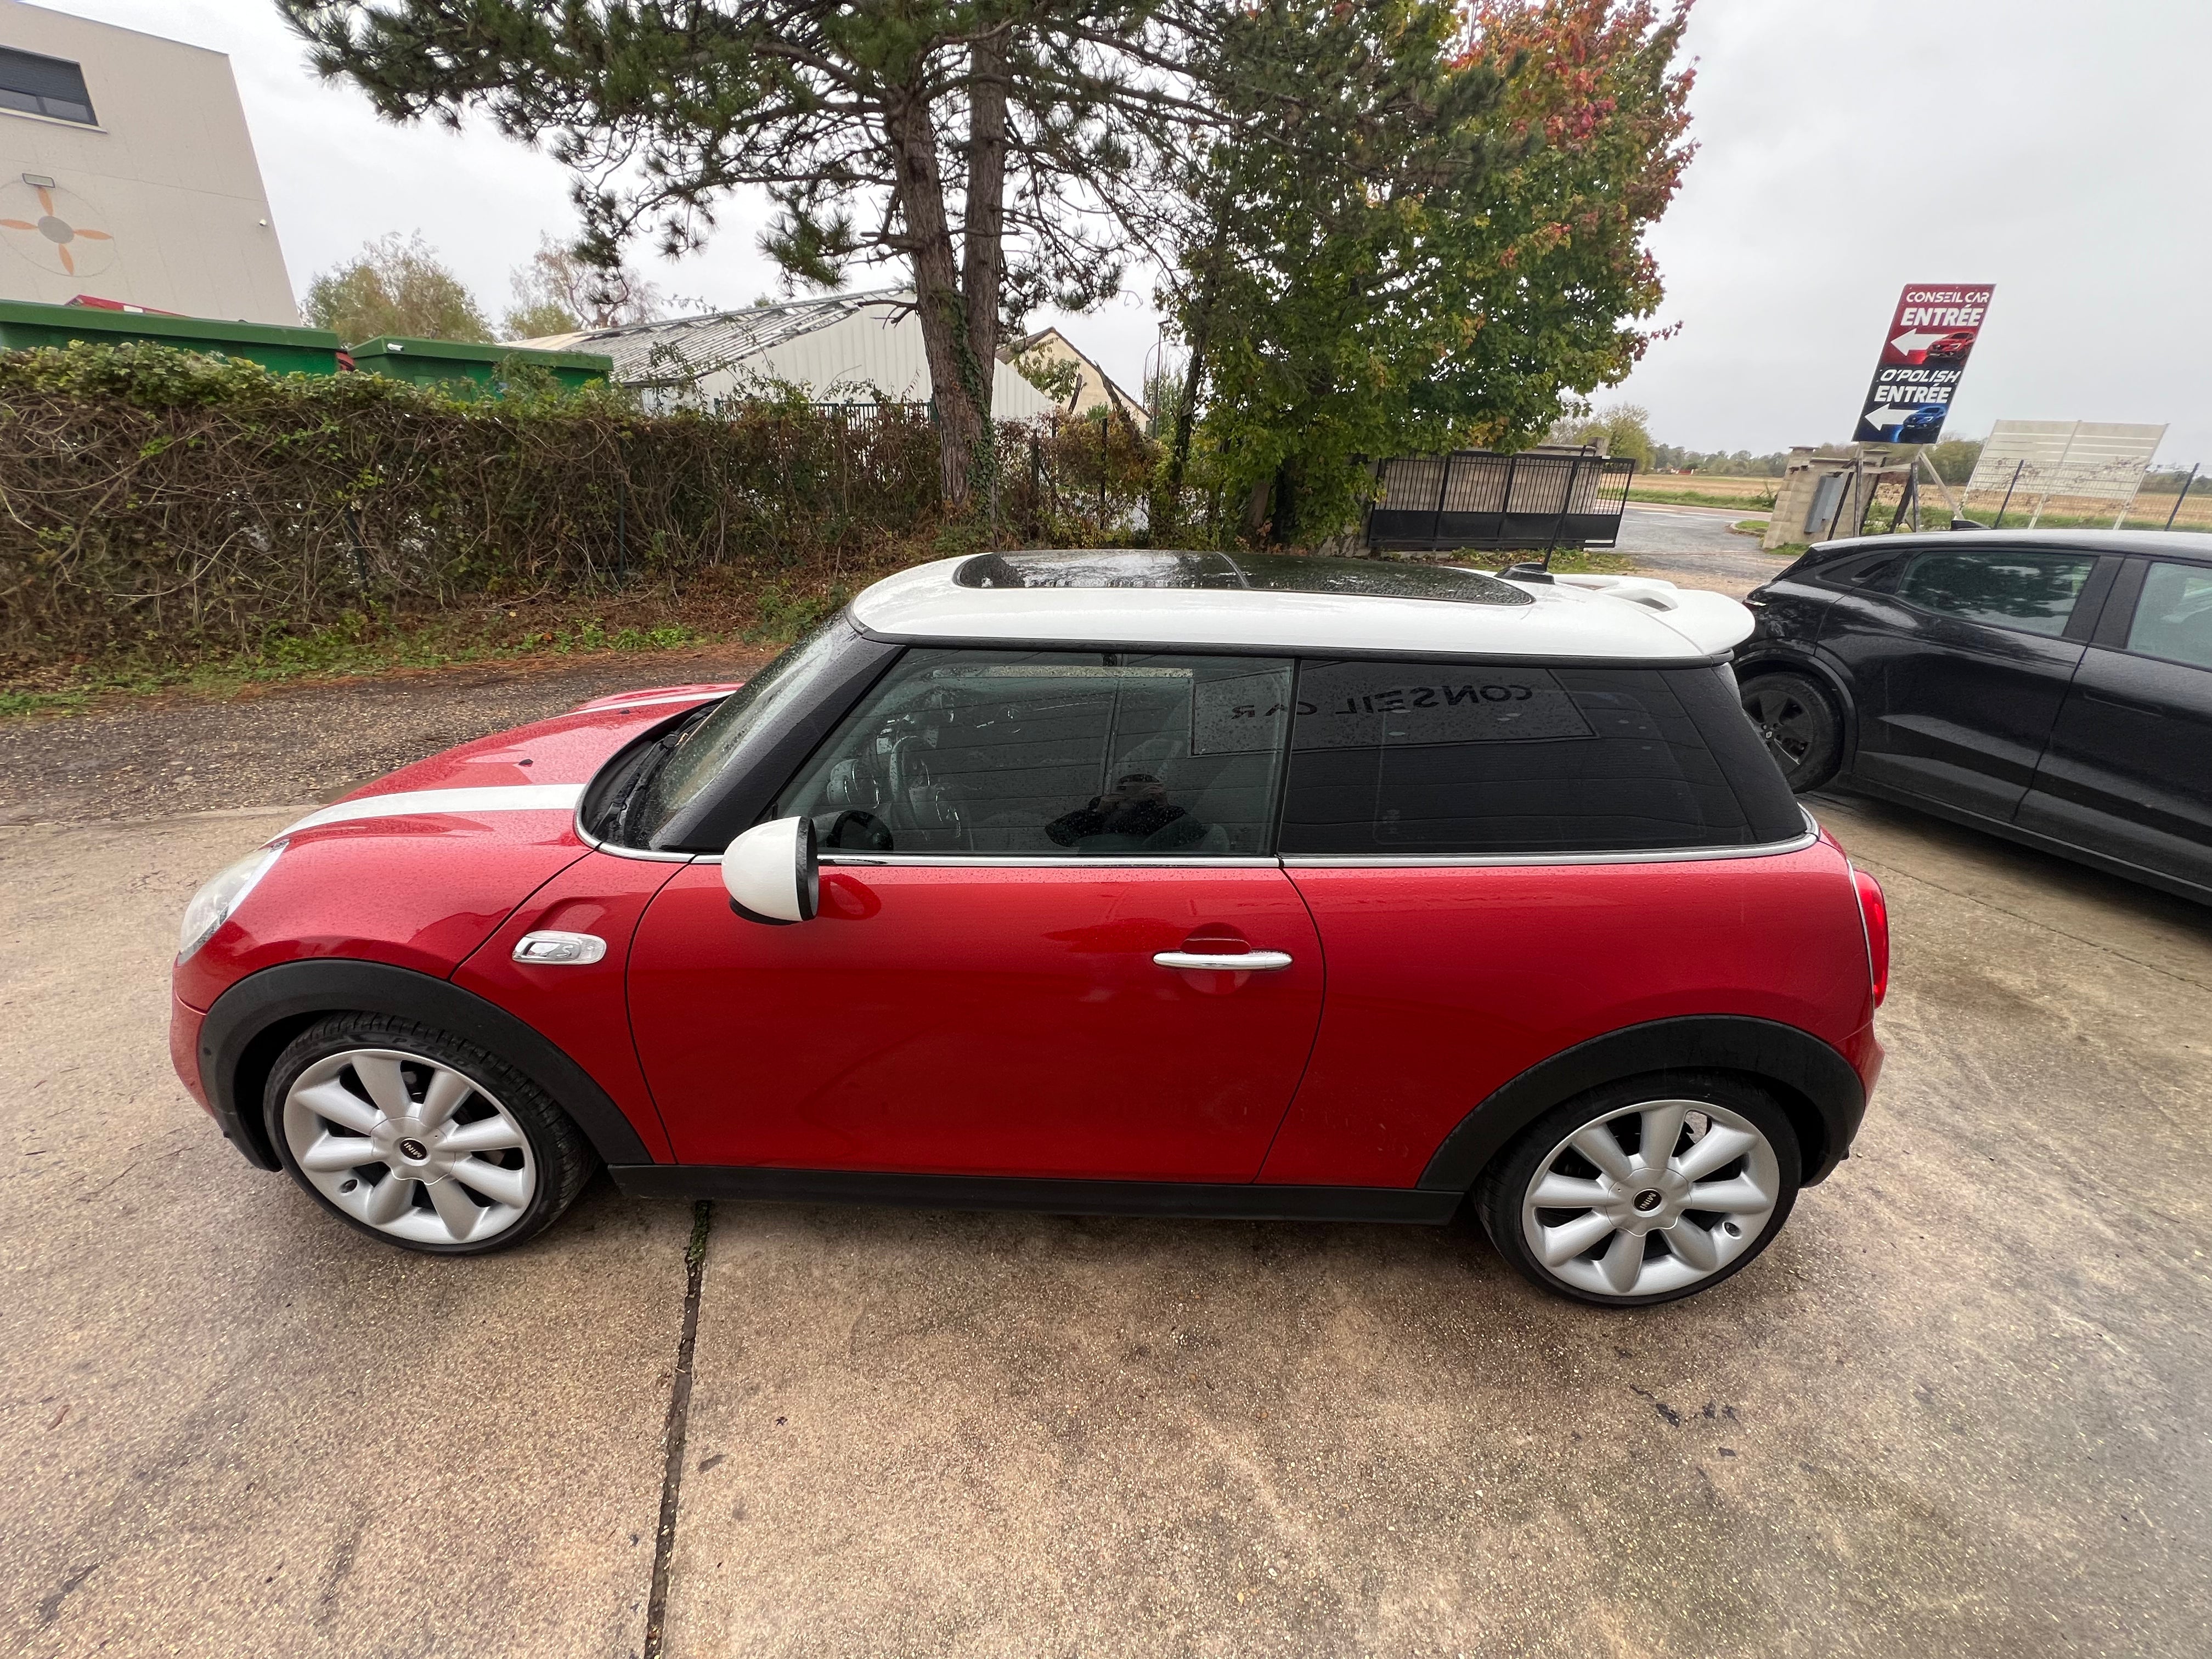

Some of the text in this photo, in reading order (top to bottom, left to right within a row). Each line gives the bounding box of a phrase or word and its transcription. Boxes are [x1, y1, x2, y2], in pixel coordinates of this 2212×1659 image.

[1906, 291, 1990, 303] CONSEIL CAR
[1900, 303, 1985, 326] ENTRÉE
[1880, 369, 1961, 383] O'POLISH
[1874, 383, 1953, 404] ENTRÉE
[556, 945, 574, 958] S
[403, 1142, 422, 1158] MINI
[1639, 1193, 1656, 1209] MINI
